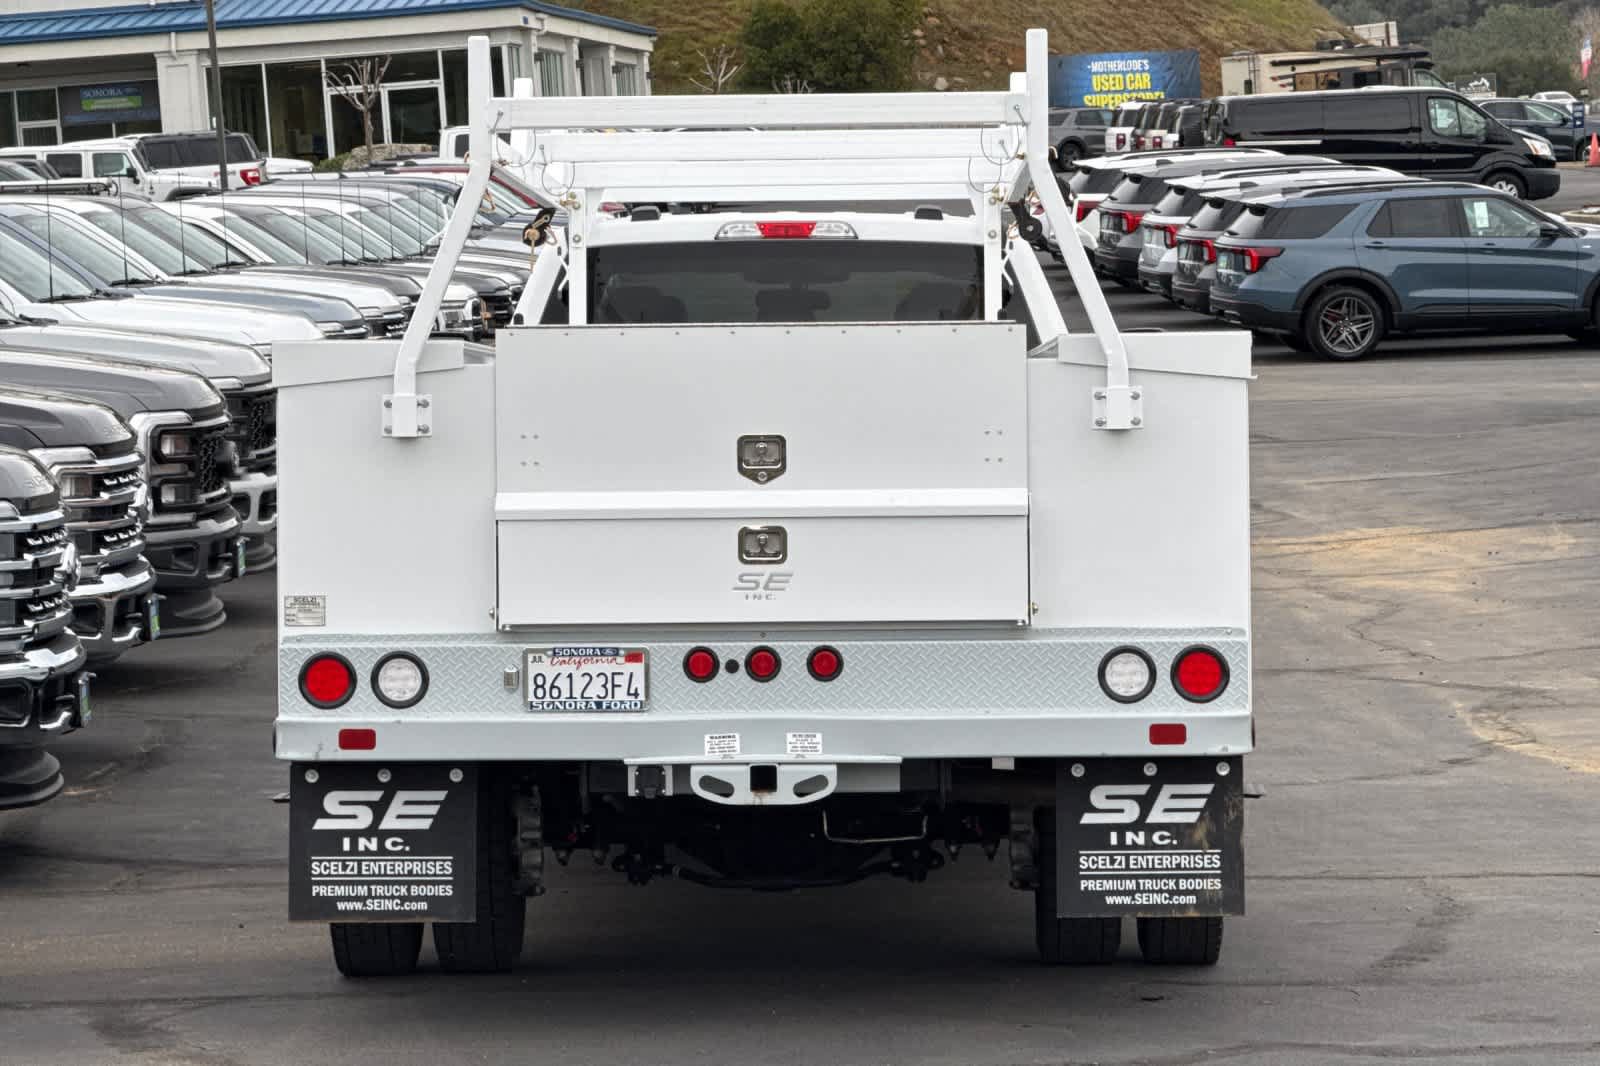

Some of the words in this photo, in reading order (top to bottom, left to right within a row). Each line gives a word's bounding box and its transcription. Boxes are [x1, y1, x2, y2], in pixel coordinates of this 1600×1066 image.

[1092, 74, 1124, 91] USED
[1126, 72, 1152, 90] CAR
[82, 88, 122, 97] SONORA
[732, 572, 794, 591] SE
[555, 648, 600, 656] SONORA
[550, 656, 617, 670] California
[533, 672, 640, 699] 86123F4
[531, 701, 597, 710] SONORA
[602, 701, 641, 710] FORD
[312, 790, 448, 830] SE
[1080, 783, 1215, 824] SE
[343, 836, 411, 851] INC.
[1110, 831, 1178, 846] INC.
[311, 861, 358, 875] SCELZI
[361, 861, 453, 875] ENTERPRISES
[1079, 856, 1126, 869] SCELZI
[1129, 855, 1221, 869] ENTERPRISES
[312, 885, 368, 896] PREMIUM
[370, 885, 408, 896] TRUCK
[410, 885, 453, 896] BODIES
[1080, 879, 1136, 891] PREMIUM
[1139, 879, 1177, 890] TRUCK
[1179, 878, 1222, 890] BODIES
[336, 899, 428, 910] www.SEINC.com
[1105, 893, 1197, 905] www.SEINC.com
